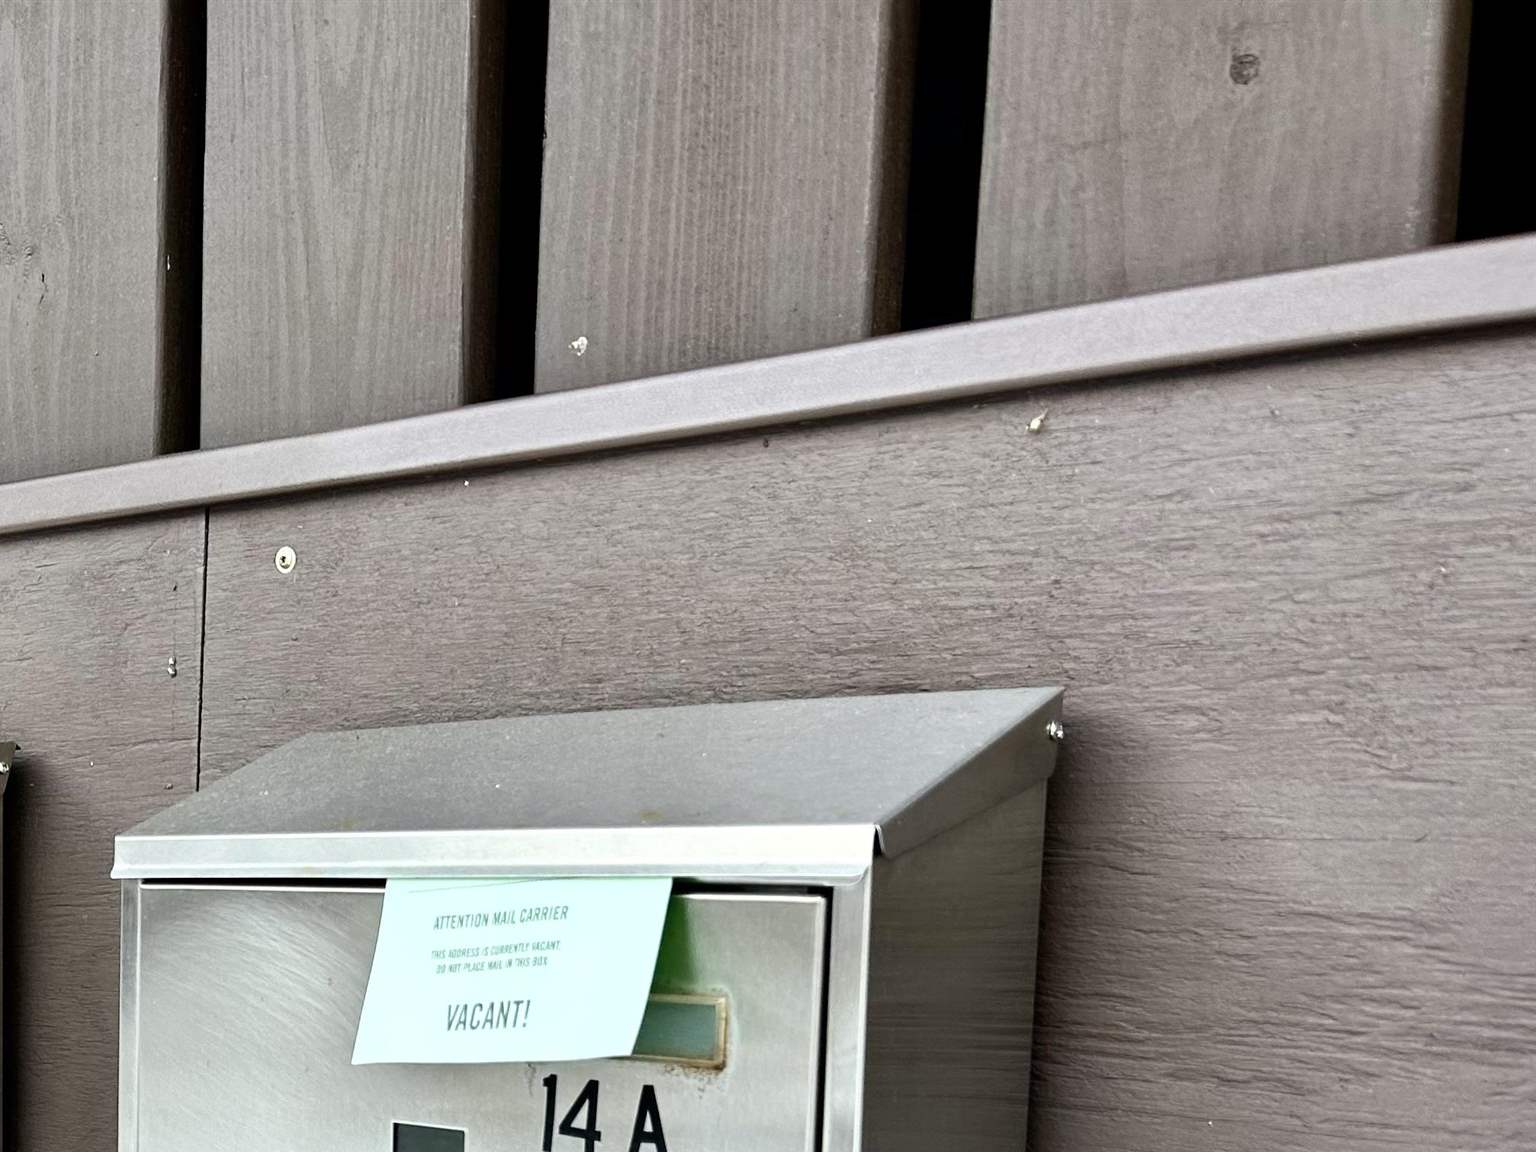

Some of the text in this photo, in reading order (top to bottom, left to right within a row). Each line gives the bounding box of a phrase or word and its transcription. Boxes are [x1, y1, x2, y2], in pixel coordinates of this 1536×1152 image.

[433, 905, 569, 930] ATTENTION MAIL CARRIER
[431, 949, 446, 960] THIS
[448, 947, 480, 959] ADDRESS
[481, 946, 489, 957] IS
[490, 942, 530, 956] CURRENTLY
[436, 964, 446, 974] DO
[449, 962, 462, 973] NOT
[463, 961, 486, 972] PLACE
[488, 959, 503, 970] MAIL
[506, 958, 513, 968] IN
[515, 957, 531, 968] THIS
[447, 999, 531, 1031] VACANT!
